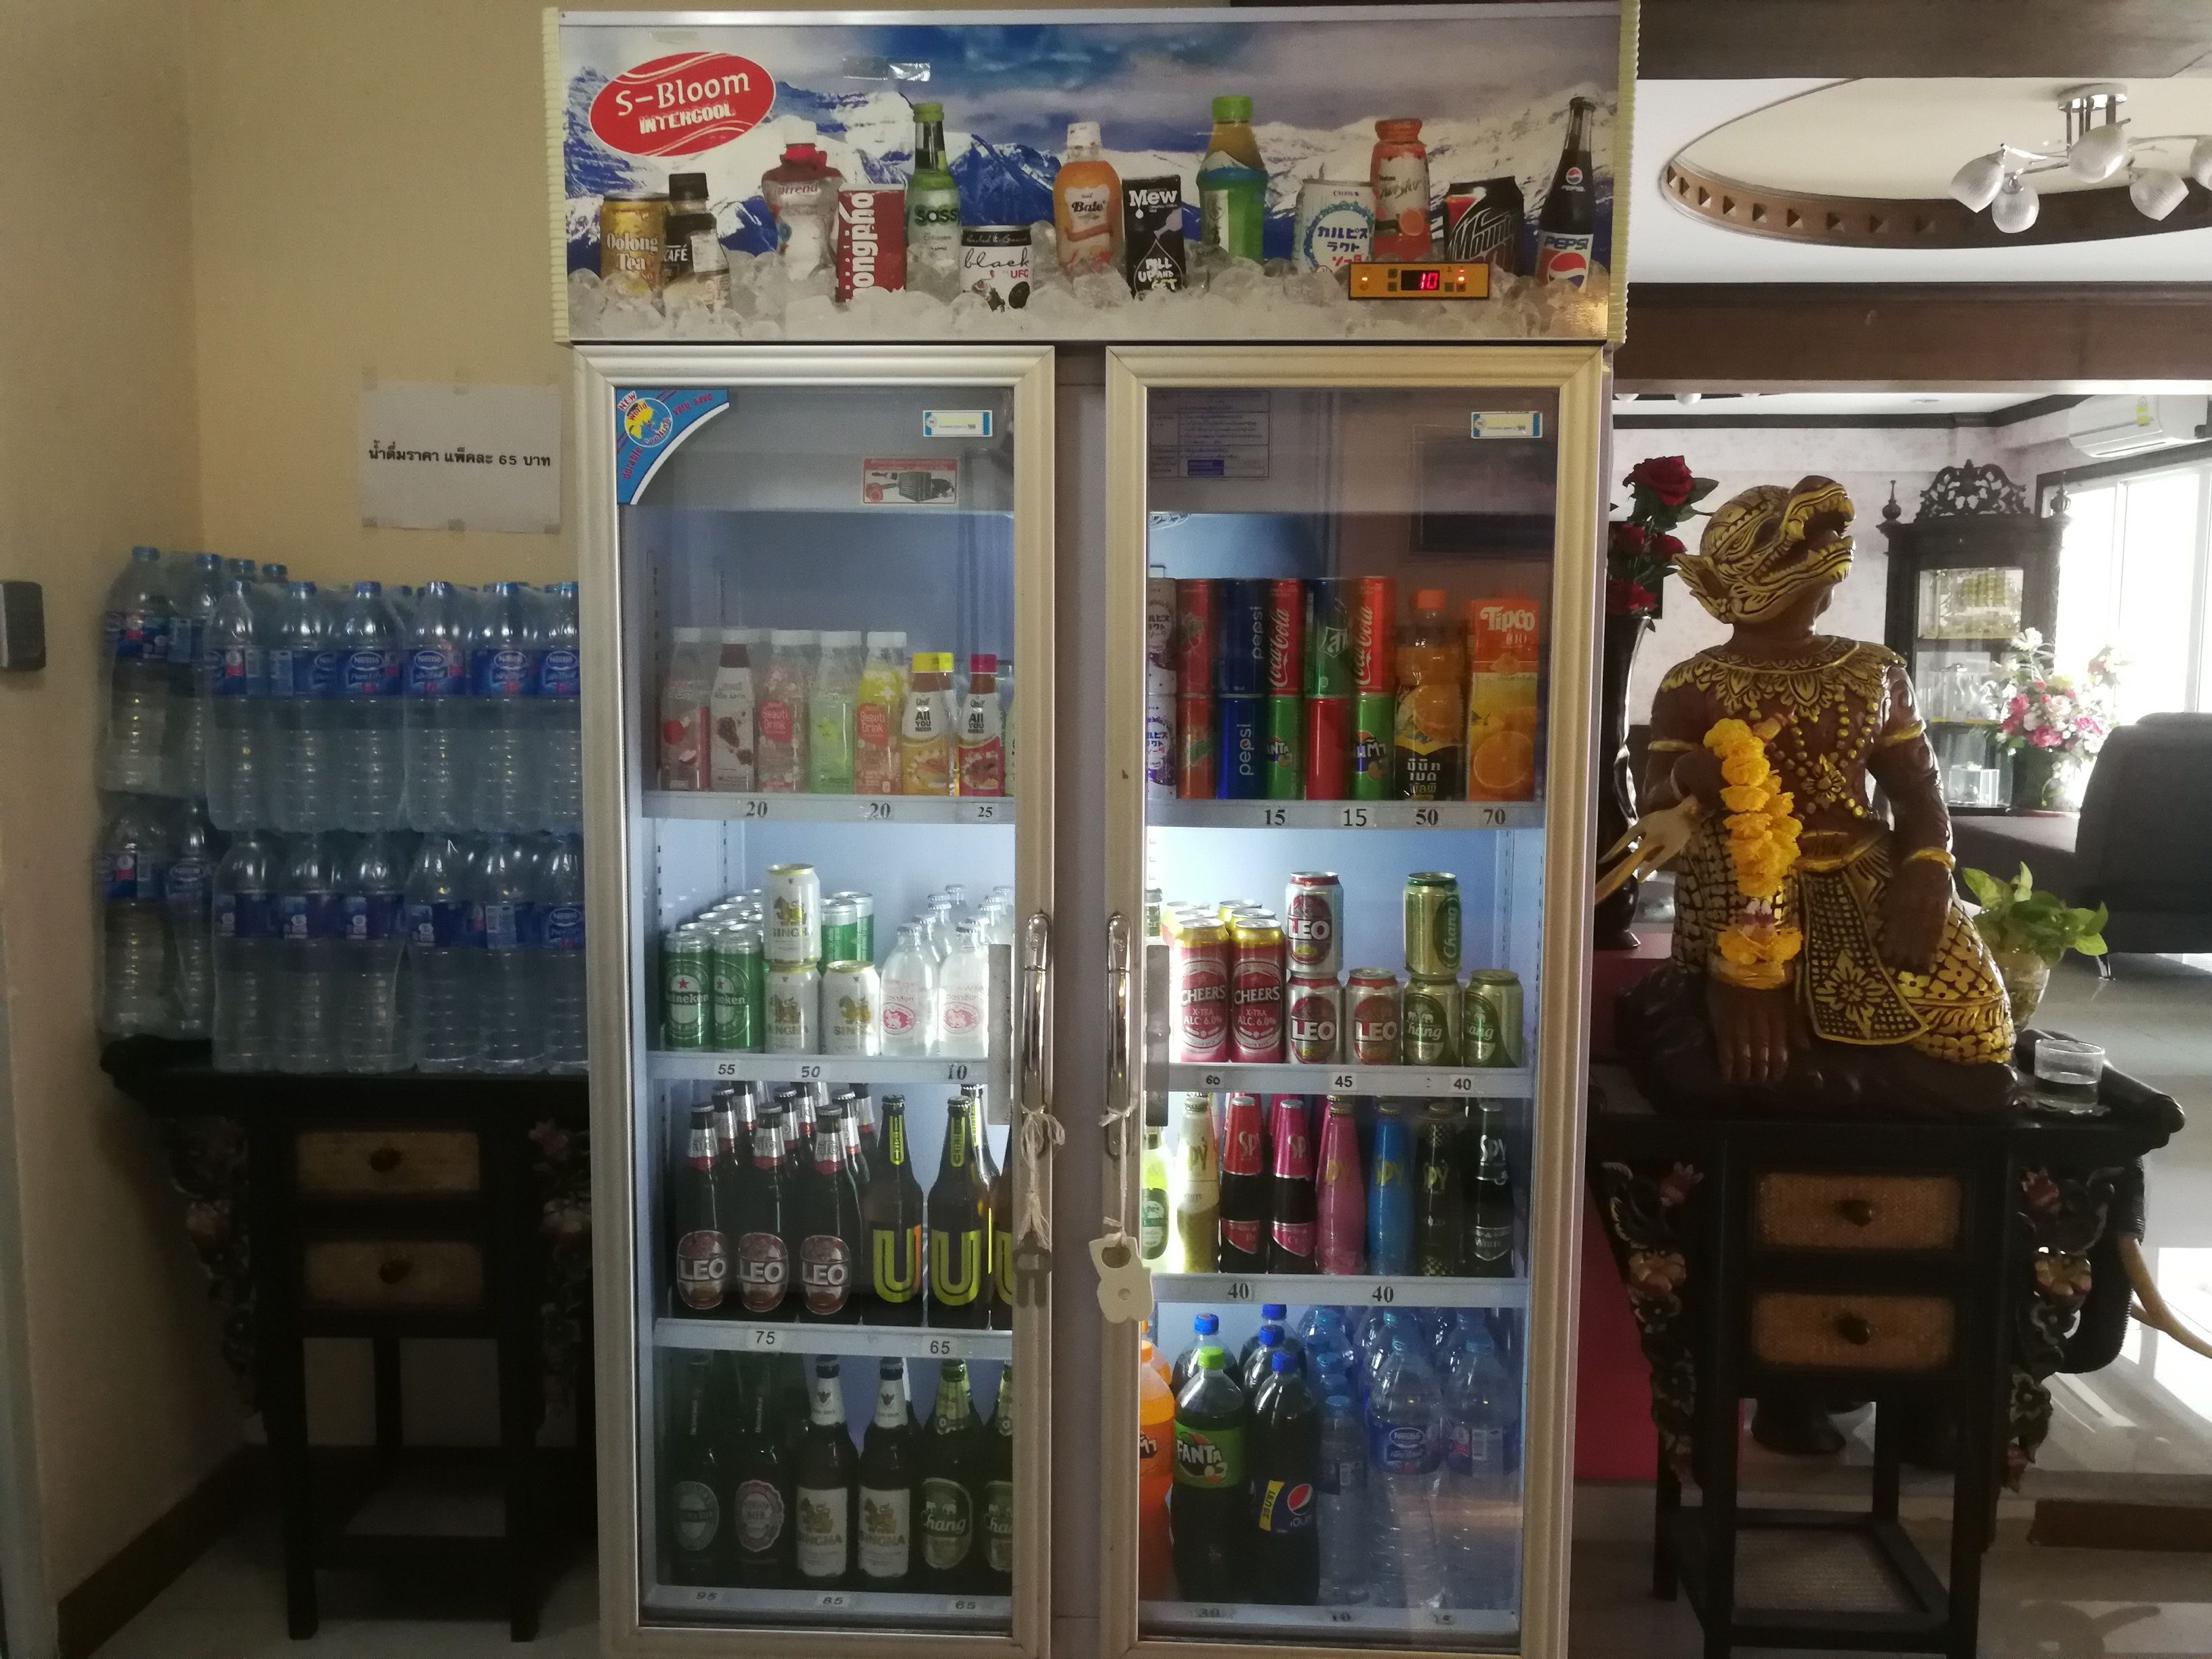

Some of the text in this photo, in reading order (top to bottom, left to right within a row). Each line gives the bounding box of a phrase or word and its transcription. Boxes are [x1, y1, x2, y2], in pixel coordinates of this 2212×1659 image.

[615, 72, 751, 117] S-Bloom
[638, 101, 737, 134] INTERCOOL
[1129, 189, 1178, 206] Mew
[607, 232, 658, 254] Oolong
[851, 192, 879, 290] ongpho
[1544, 237, 1589, 250] PEPSI
[617, 253, 646, 270] Tea
[964, 247, 1030, 268] black
[1420, 272, 1439, 291] 10
[628, 401, 648, 421] World
[499, 455, 517, 466] 65
[523, 455, 551, 466] บาท
[1479, 605, 1536, 632] Tipco
[1252, 606, 1264, 659] pepsi
[1240, 723, 1254, 776] pepsi
[745, 801, 769, 817] 20
[869, 802, 891, 819] 20
[977, 806, 994, 818] 25
[1265, 809, 1286, 825] 15
[1344, 808, 1368, 827] 15
[1416, 808, 1439, 826] 50
[1483, 808, 1506, 825] 70
[1288, 920, 1330, 941] LEO
[1181, 985, 1226, 1004] CHEERS
[1234, 986, 1280, 1004] CHEERS
[1246, 1008, 1267, 1016] X-TRA
[1292, 1021, 1336, 1041] LEO
[1355, 1021, 1397, 1041] LEO
[718, 1064, 736, 1076] 55
[801, 1066, 821, 1078] 50
[947, 1063, 968, 1080] 10
[1206, 1075, 1220, 1085] 60
[1334, 1076, 1353, 1087] 45
[1454, 1078, 1471, 1090] 40
[680, 1258, 727, 1281] LEO
[740, 1261, 783, 1282] LEO
[873, 1226, 920, 1303] U
[931, 1229, 981, 1307] U
[802, 1264, 848, 1286] LEO
[1227, 1282, 1250, 1300] 40
[1372, 1286, 1395, 1303] 40
[756, 1330, 775, 1345] 75
[930, 1340, 950, 1355] 65
[1176, 1439, 1224, 1464] FANTA
